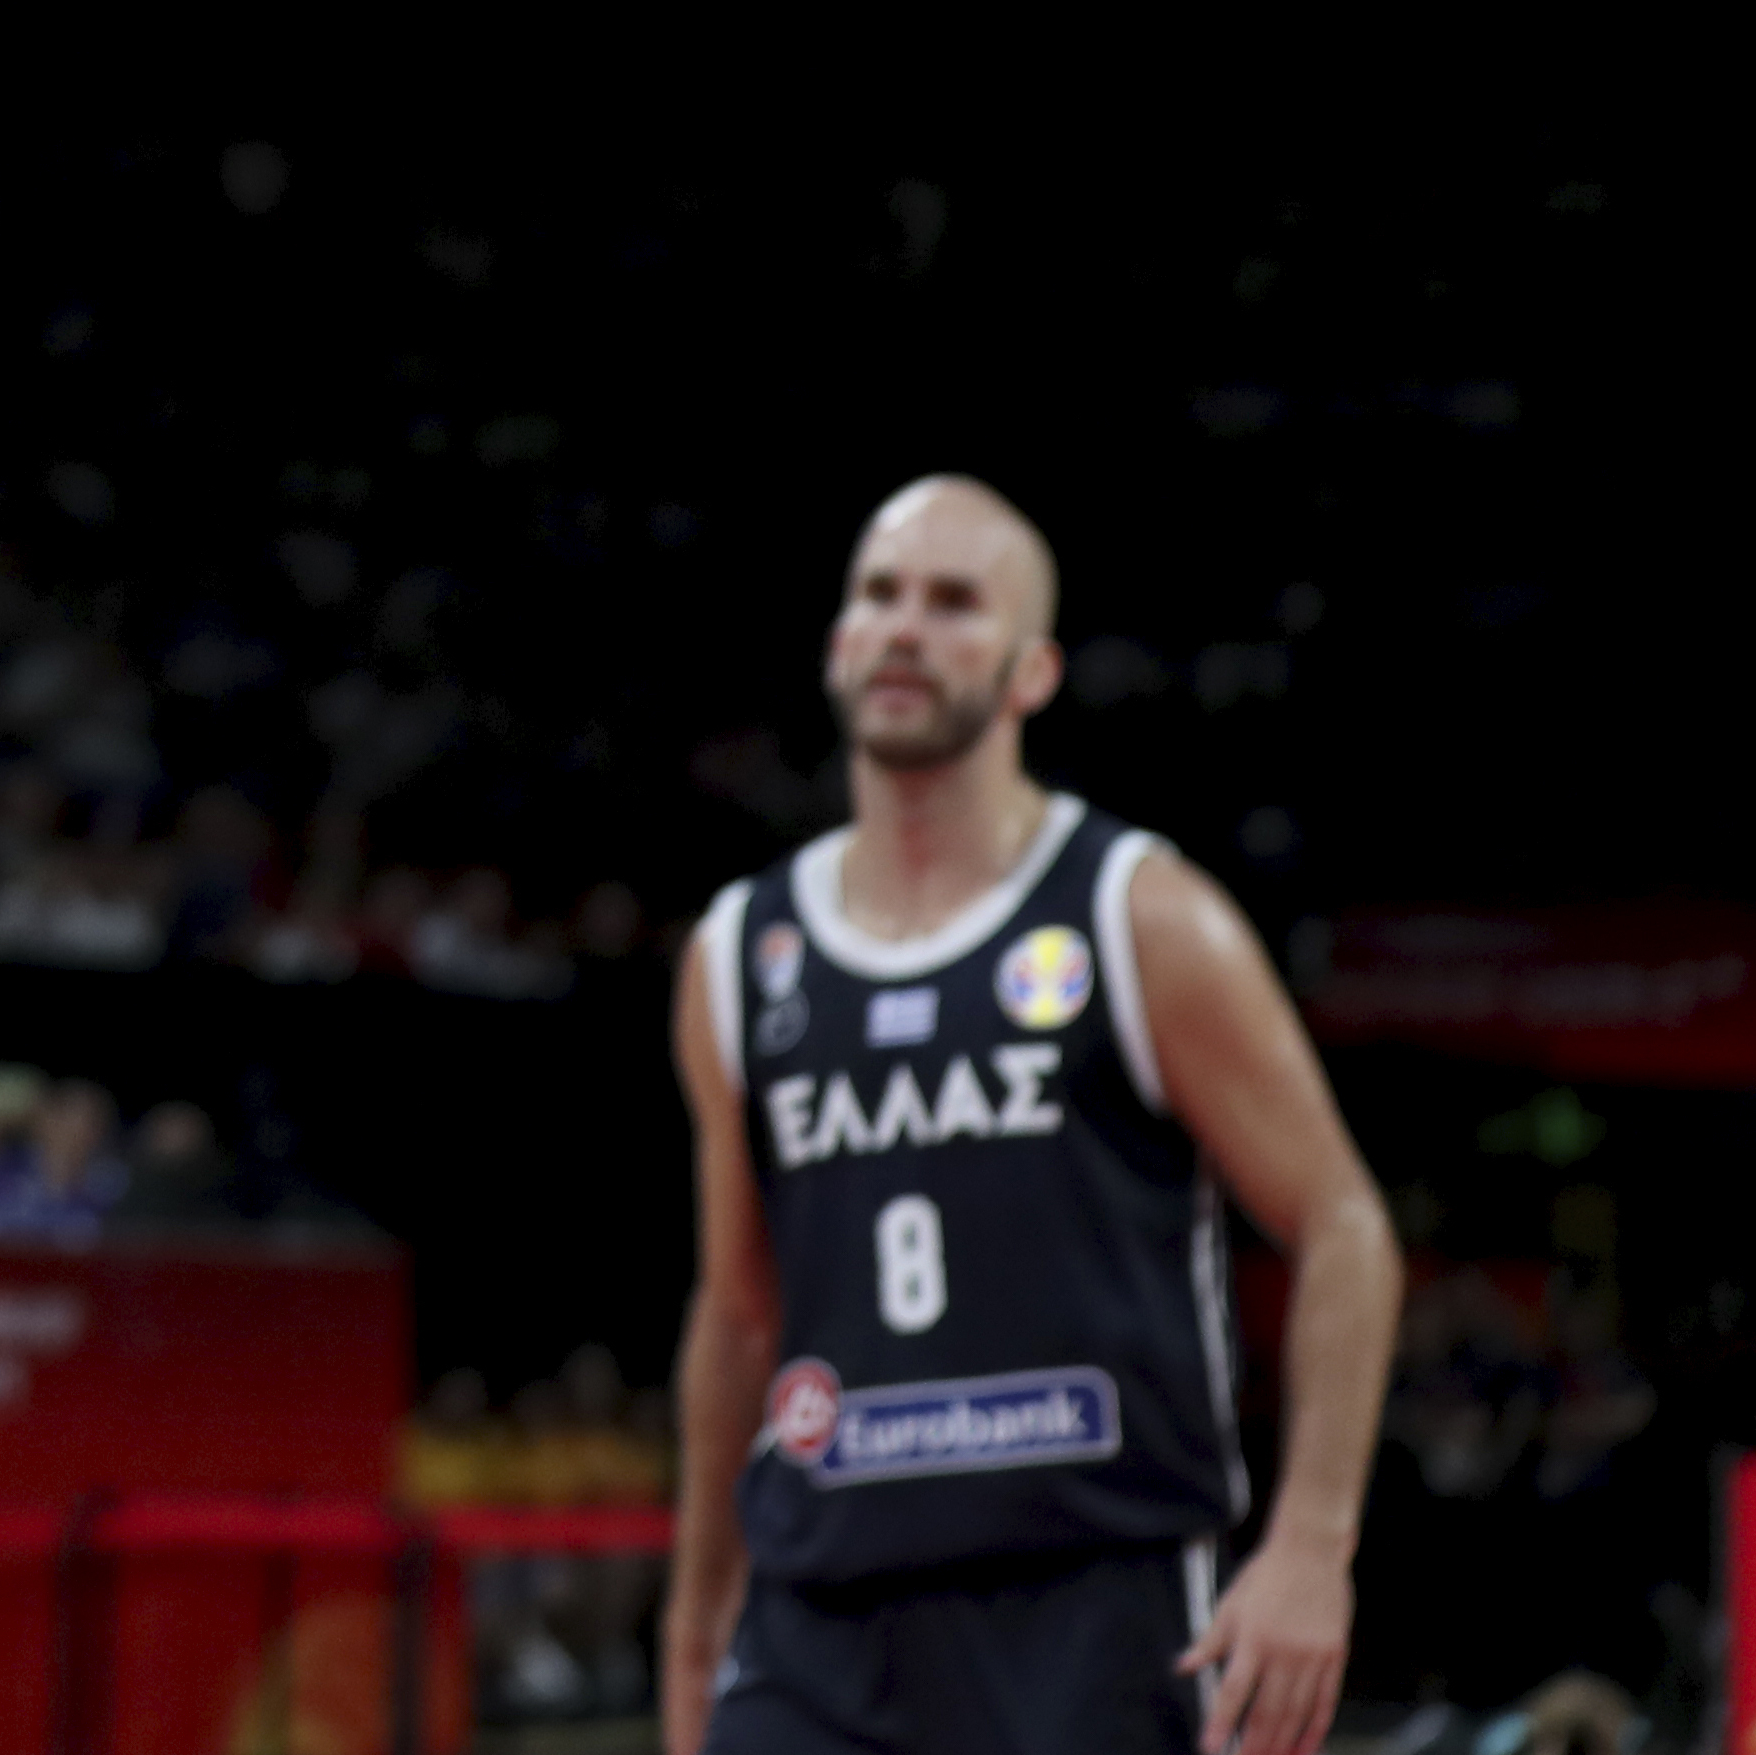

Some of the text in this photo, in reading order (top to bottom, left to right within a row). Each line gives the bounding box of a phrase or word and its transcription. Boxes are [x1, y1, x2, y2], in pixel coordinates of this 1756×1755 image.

[764, 1040, 1066, 1171] ΕΛΛΑΣ
[874, 1192, 949, 1335] 8
[843, 1390, 1088, 1457] Eurobank
